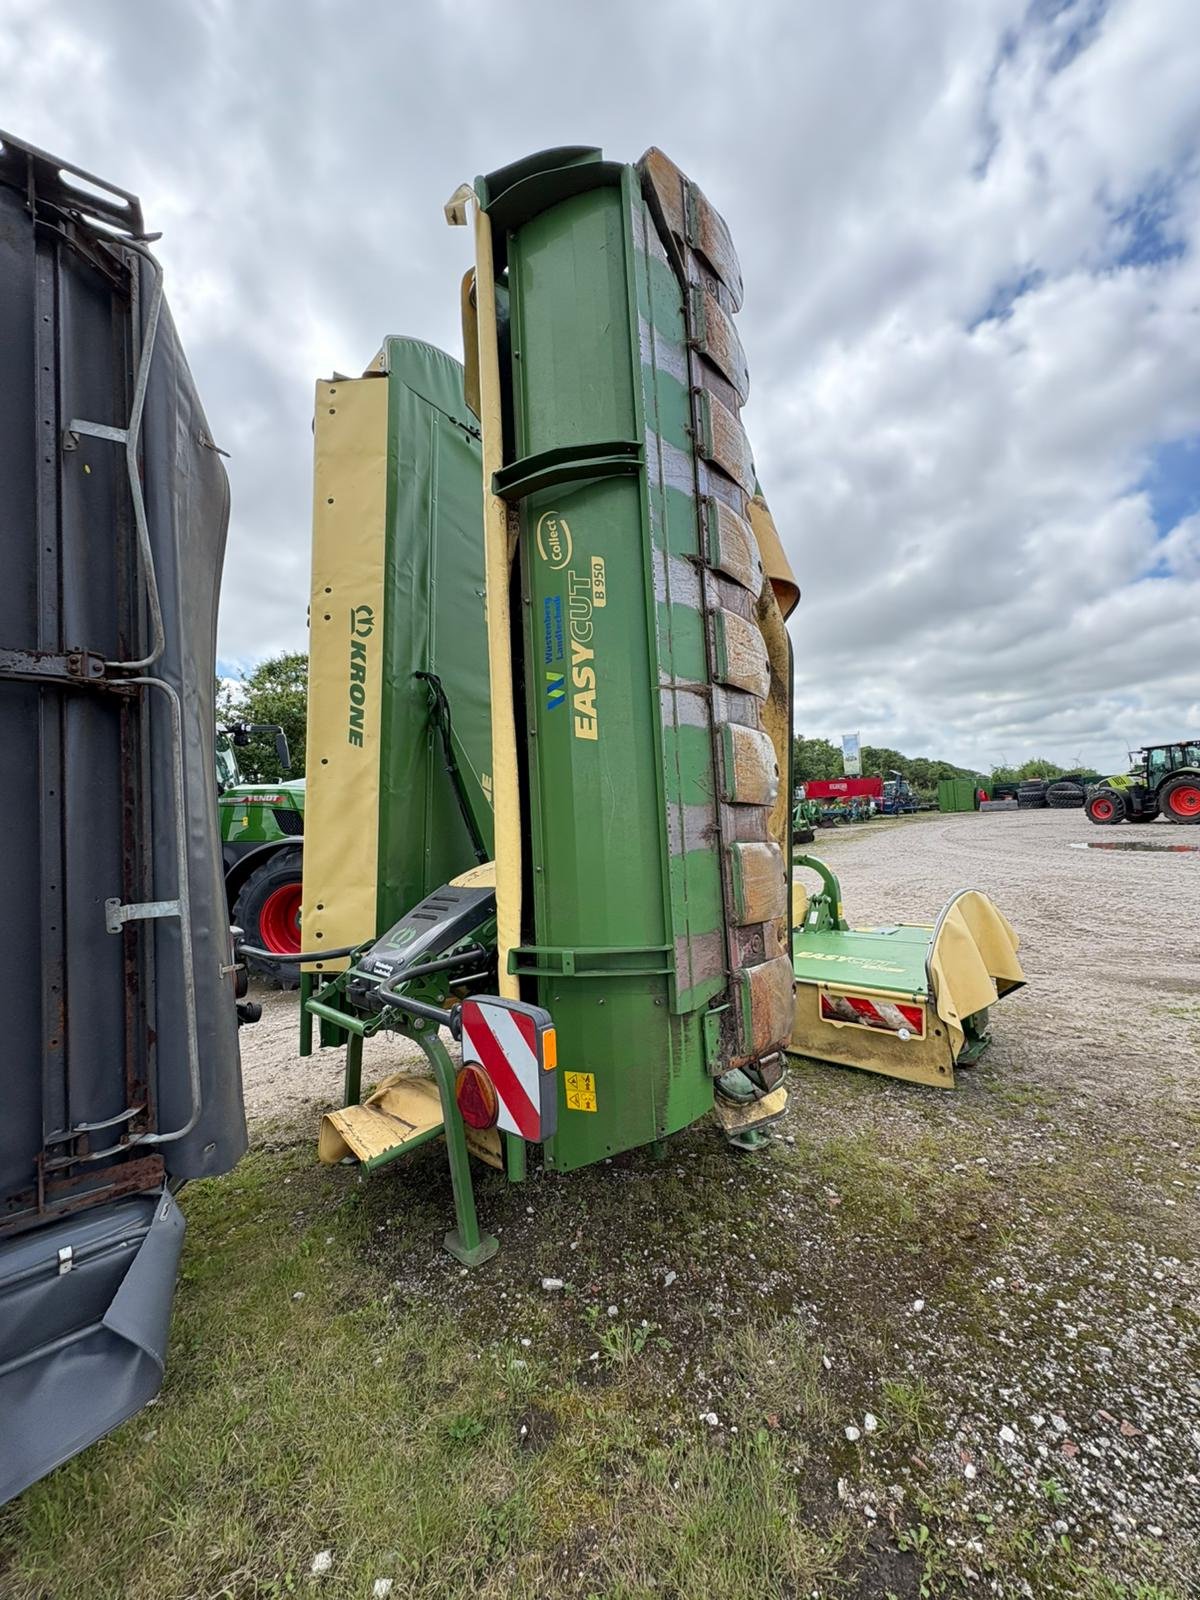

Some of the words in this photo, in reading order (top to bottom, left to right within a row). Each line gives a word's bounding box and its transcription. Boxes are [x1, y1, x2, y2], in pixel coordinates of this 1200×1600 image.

[547, 520, 562, 561] Collect
[592, 563, 605, 588] 950
[594, 590, 606, 600] B
[568, 571, 598, 741] EASYCUT
[349, 639, 366, 748] KRONE
